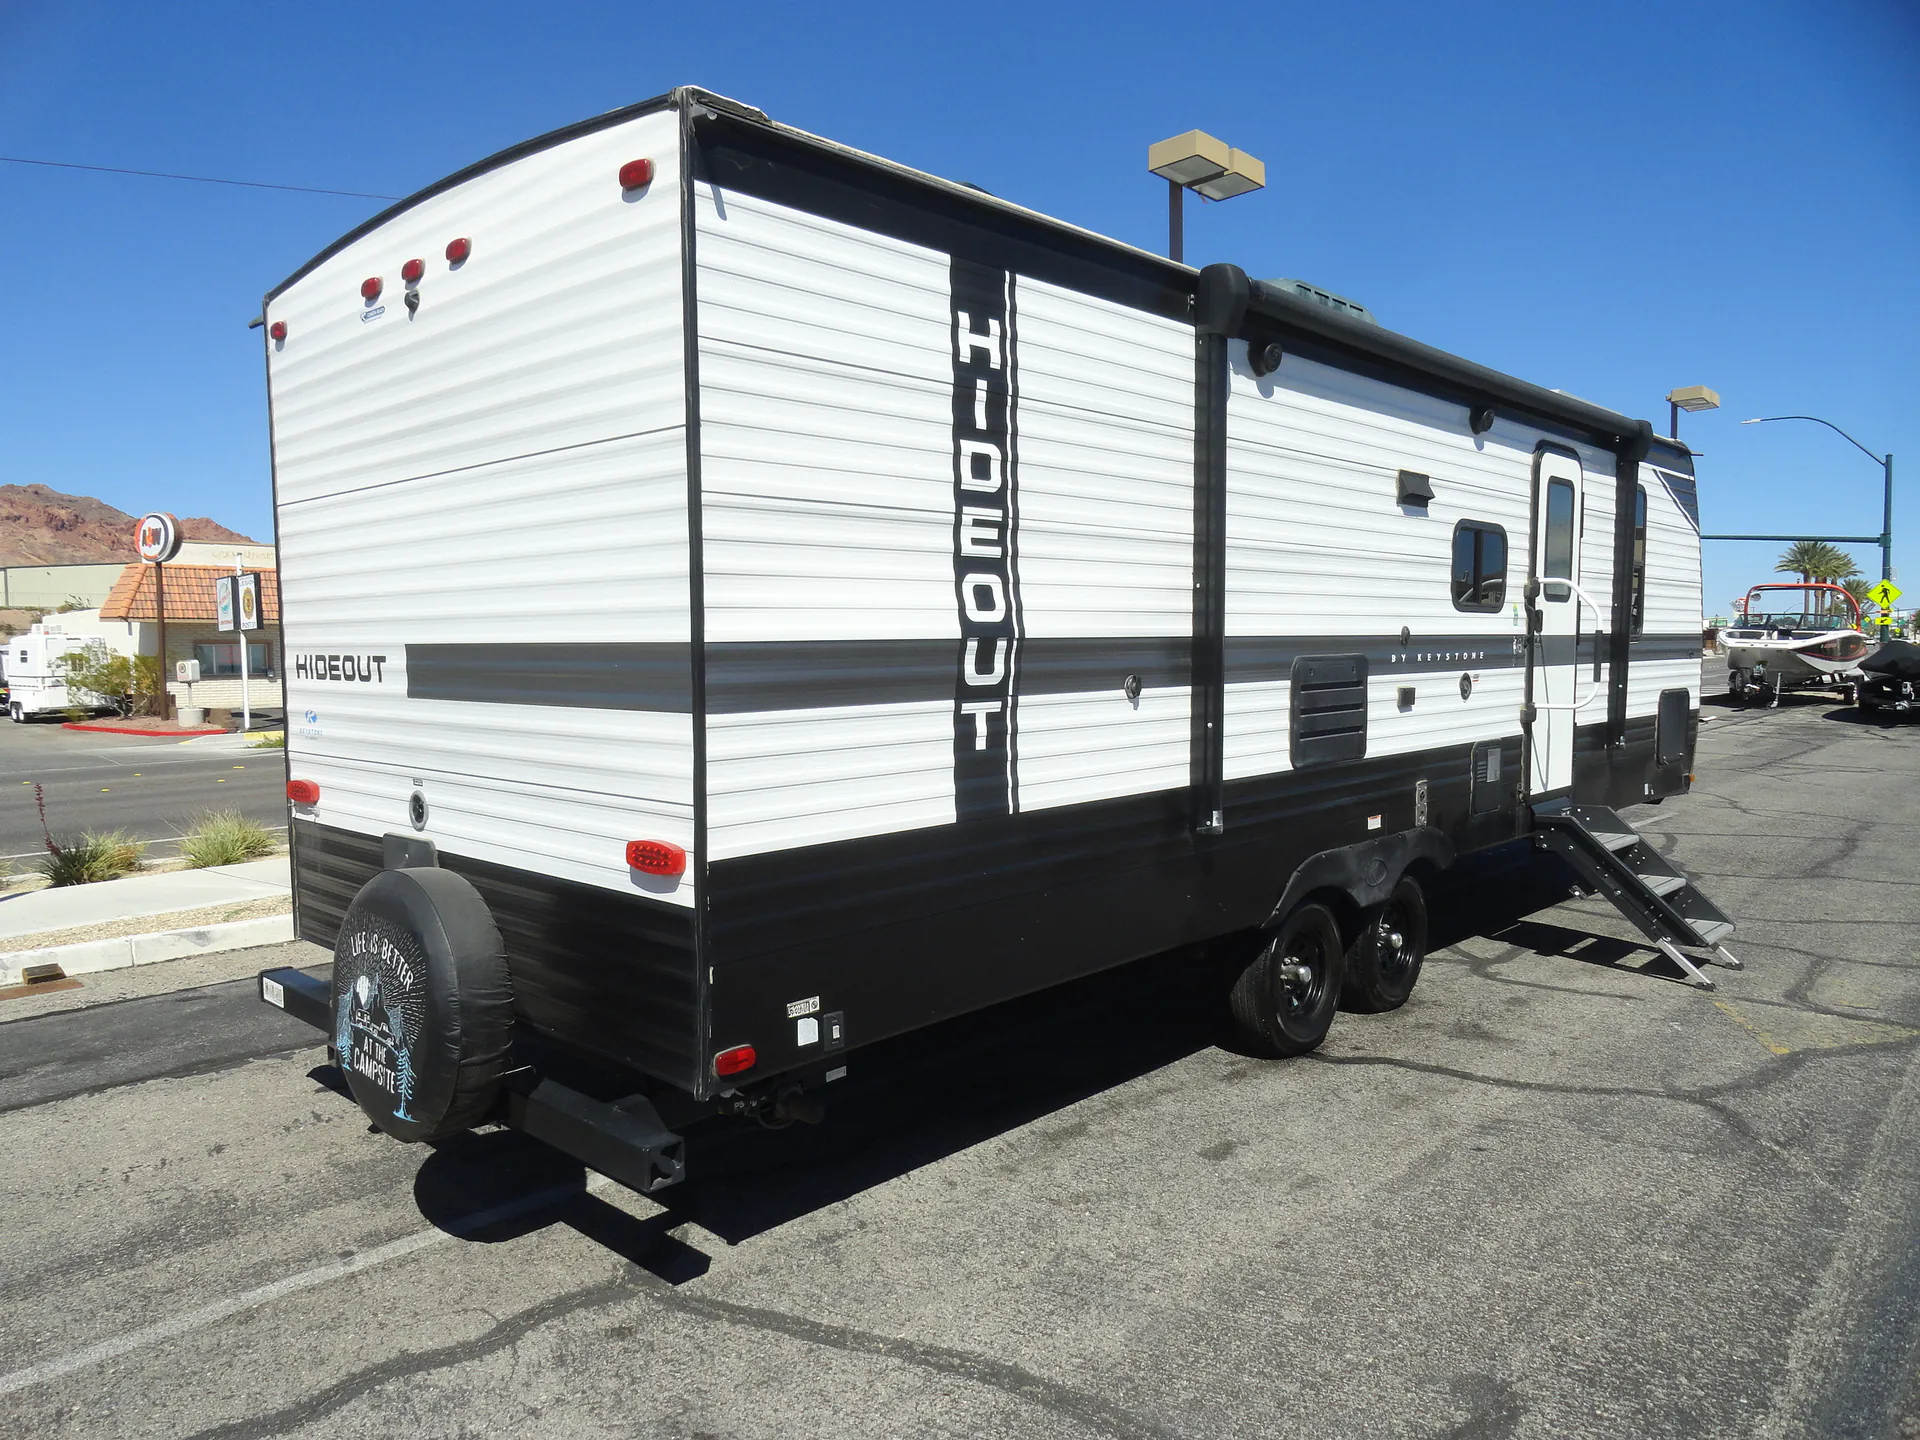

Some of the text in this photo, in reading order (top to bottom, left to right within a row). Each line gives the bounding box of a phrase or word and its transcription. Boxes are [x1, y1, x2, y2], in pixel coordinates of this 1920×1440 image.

[141, 526, 162, 548] A&W
[957, 310, 1007, 751] HIDEOUT
[296, 654, 386, 683] HIDEOUT
[1391, 651, 1484, 663] BY KEYSTONE
[350, 931, 414, 992] LIFE IS BETTER
[363, 1036, 387, 1065] AT THE
[353, 1047, 396, 1094] CAMPSITE
